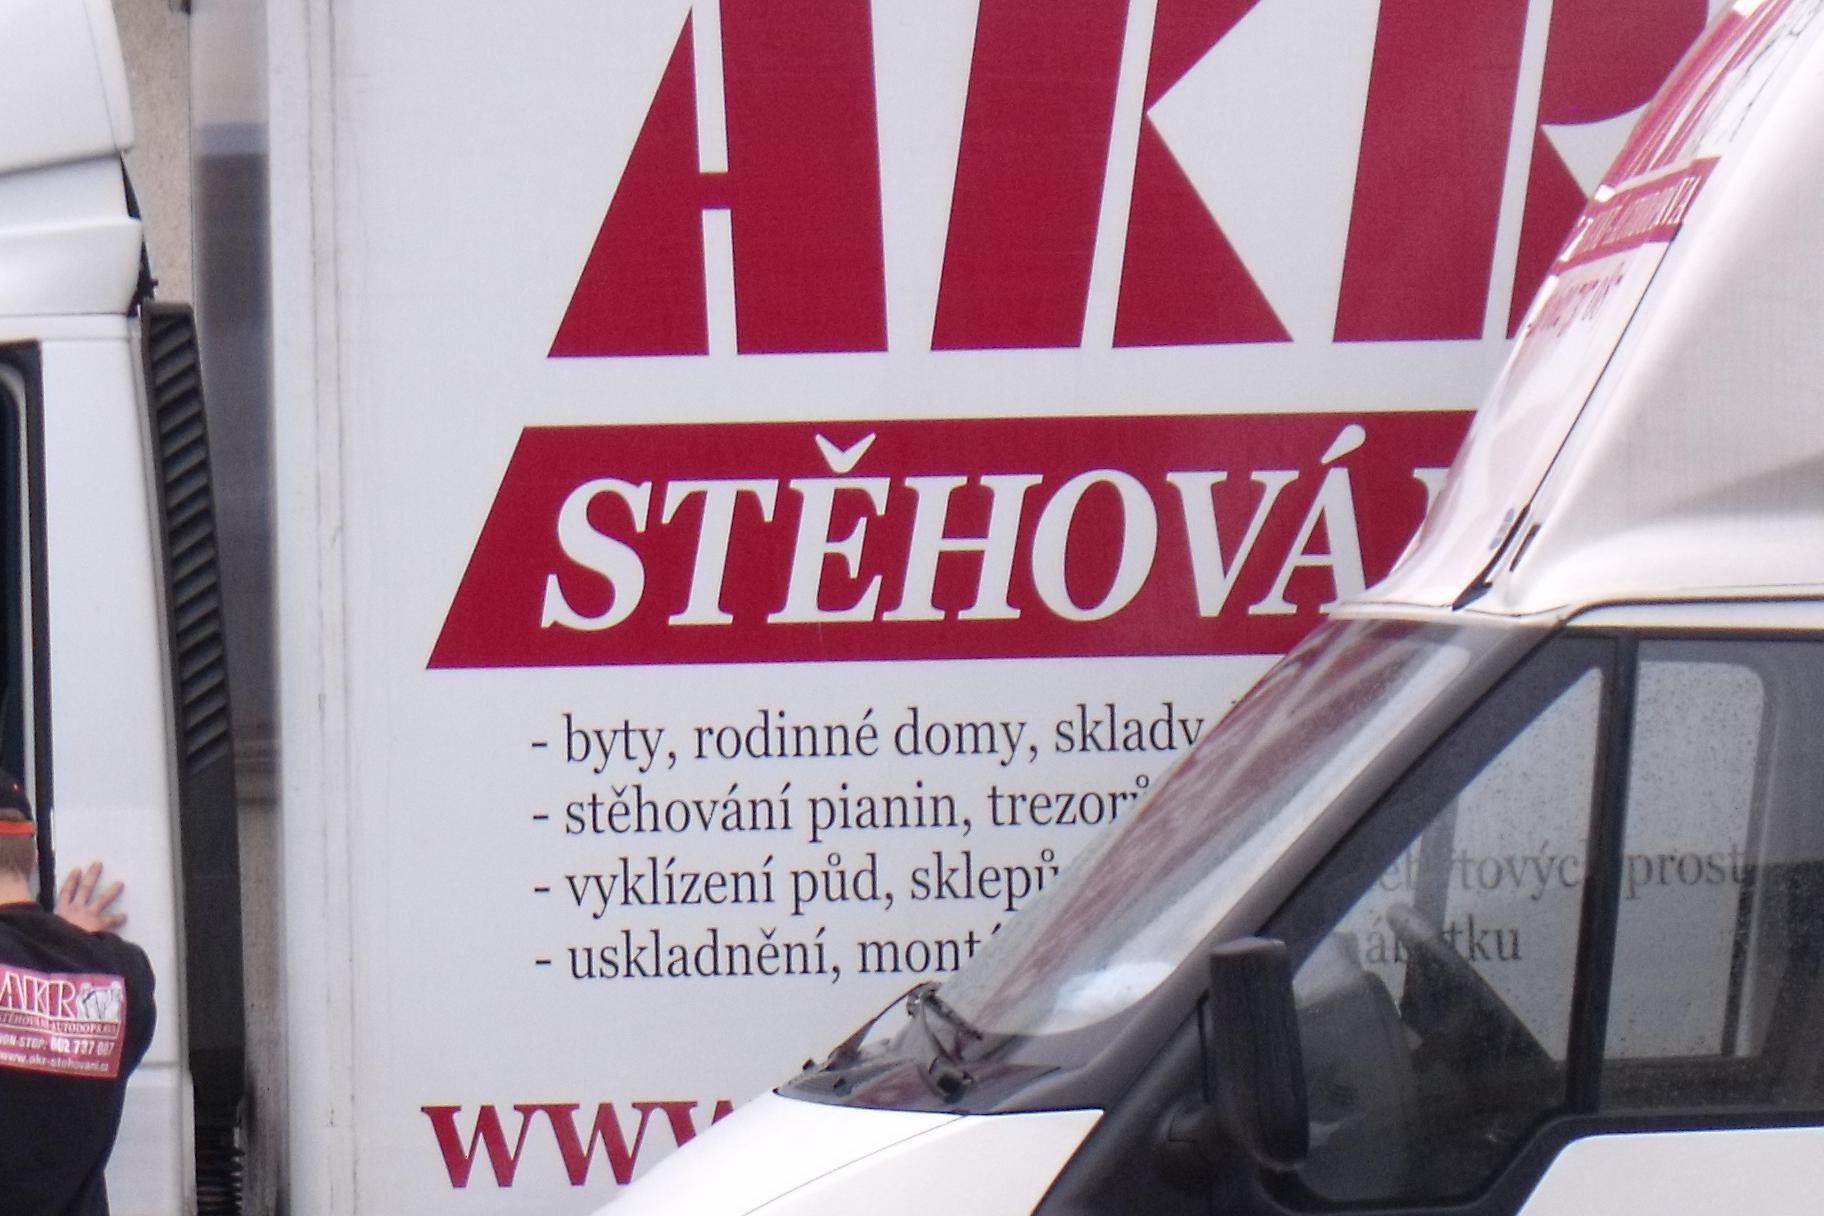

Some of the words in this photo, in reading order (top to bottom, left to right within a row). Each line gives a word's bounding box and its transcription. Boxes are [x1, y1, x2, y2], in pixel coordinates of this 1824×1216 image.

[564, 713, 677, 774] byty,
[695, 707, 878, 759] rodinné
[894, 706, 1038, 767] domy,
[566, 781, 792, 835] stěhování
[808, 780, 972, 844] pianin,
[565, 854, 774, 919] vyklízení
[790, 852, 894, 916] půd,
[567, 926, 841, 985] uskladnění,
[857, 922, 1002, 973] mont
[74, 1039, 95, 1055] 737
